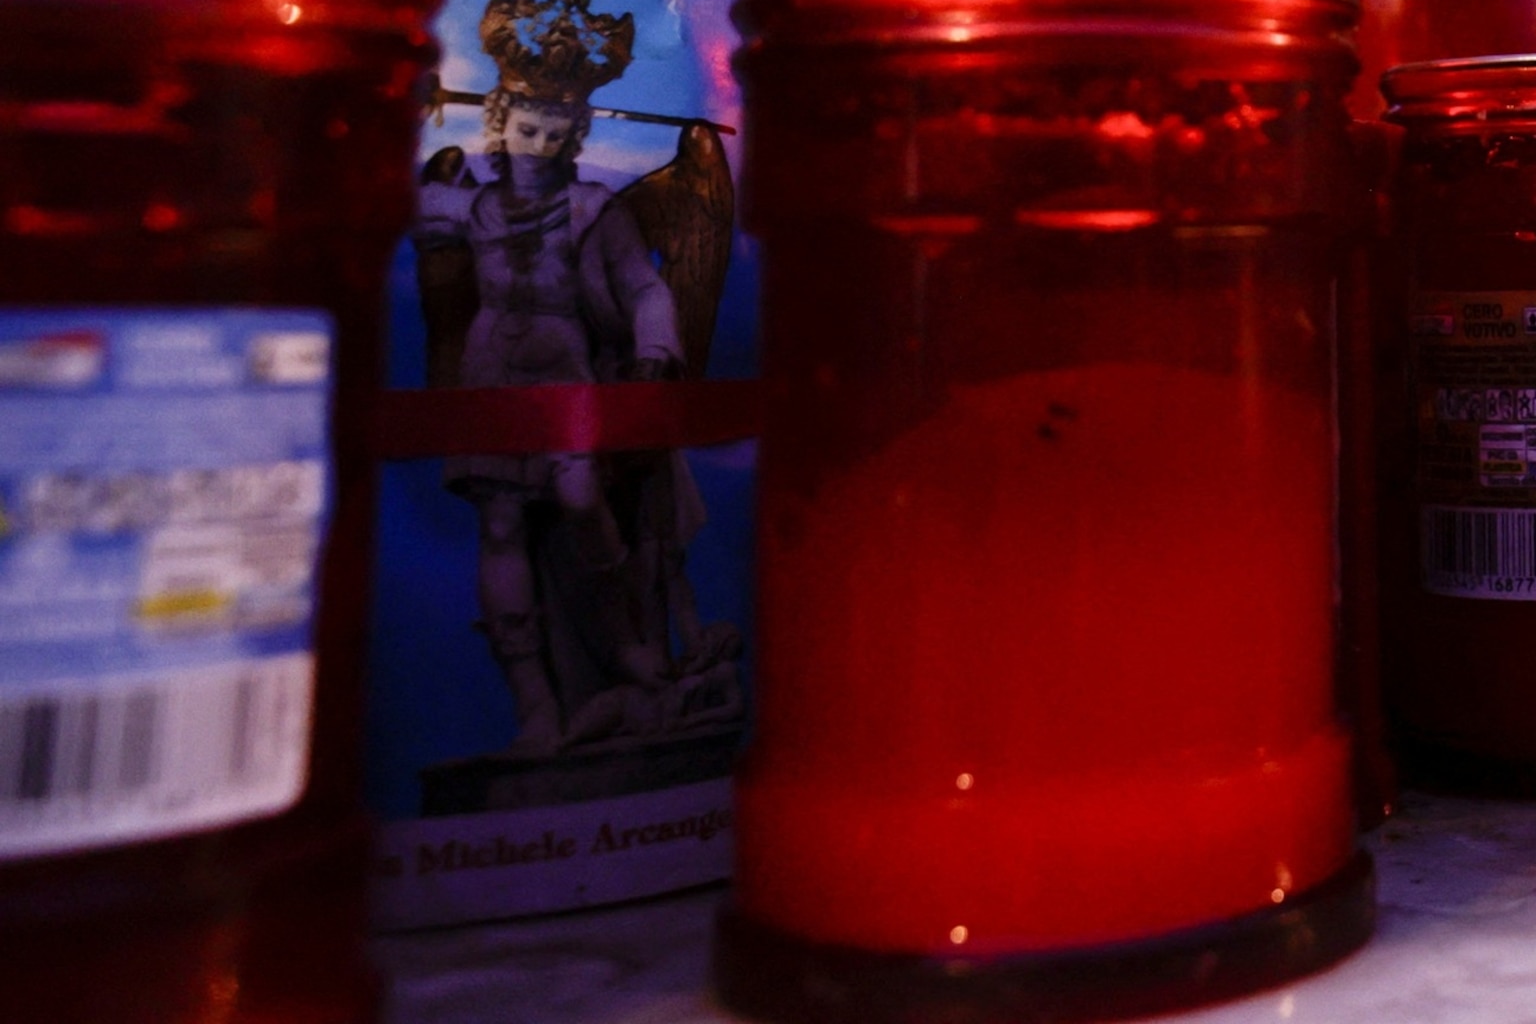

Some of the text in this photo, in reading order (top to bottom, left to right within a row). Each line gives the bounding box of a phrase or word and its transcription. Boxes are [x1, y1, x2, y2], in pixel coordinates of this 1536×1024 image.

[1463, 303, 1503, 320] CERO
[1463, 321, 1516, 338] VOTIVO
[418, 831, 576, 875] Michele
[590, 808, 732, 854] Arcange
